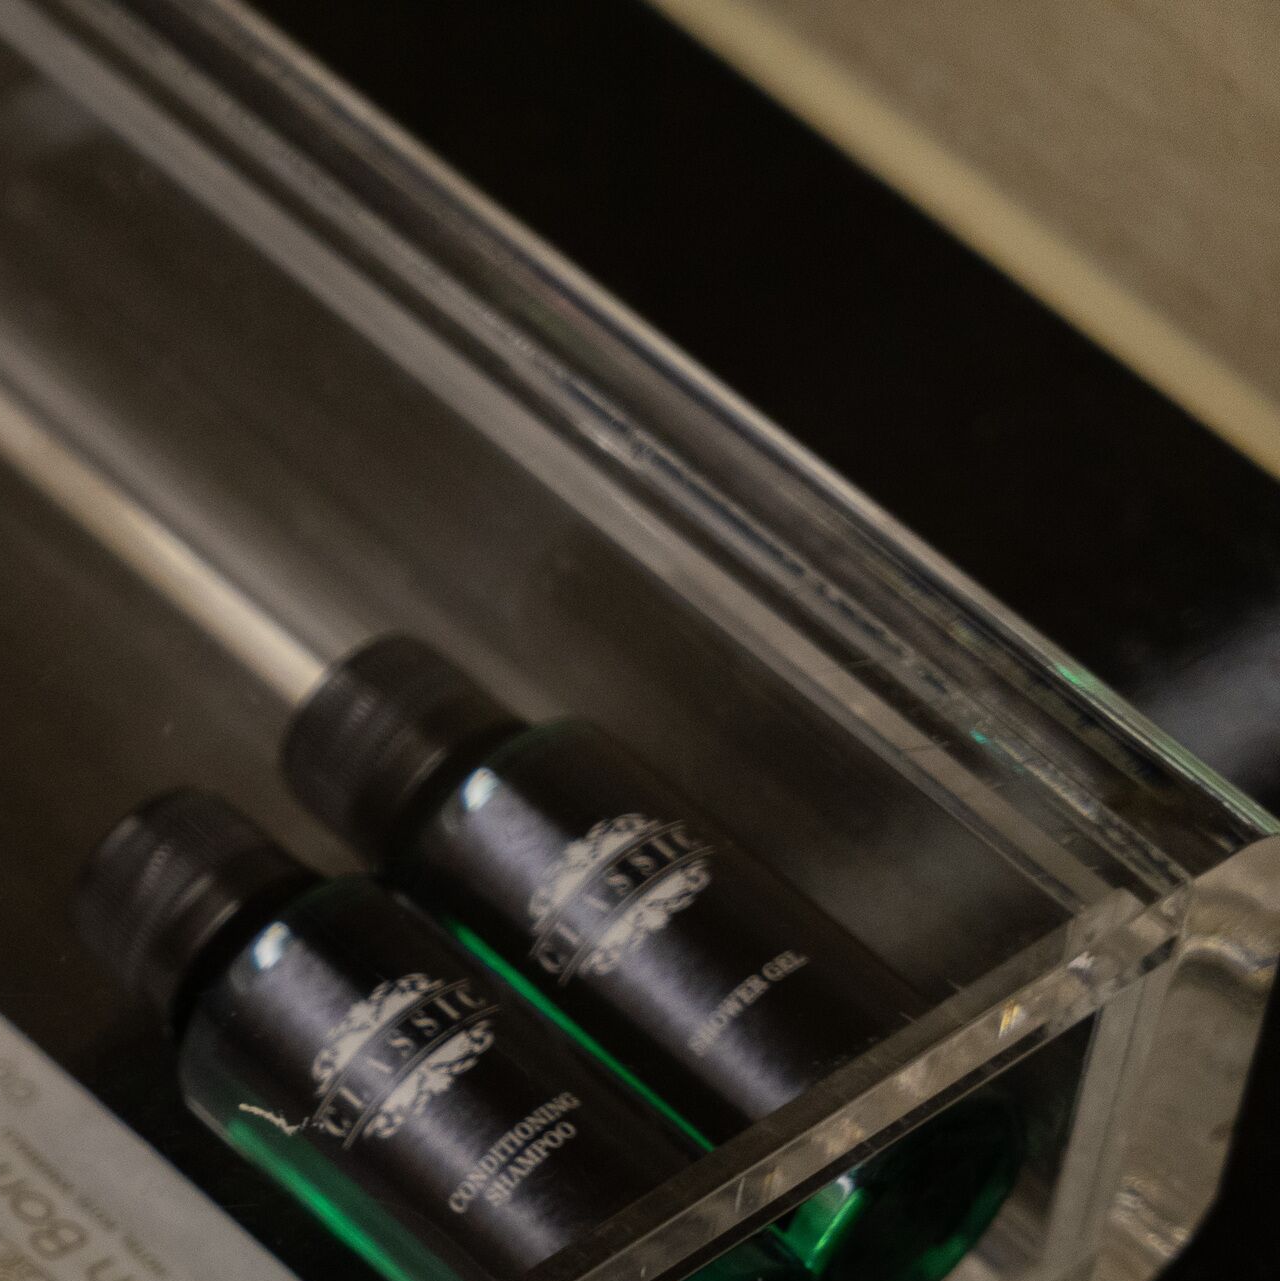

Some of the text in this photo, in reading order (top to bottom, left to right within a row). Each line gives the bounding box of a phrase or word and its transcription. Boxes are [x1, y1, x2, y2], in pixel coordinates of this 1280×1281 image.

[537, 826, 697, 976] CLASSIC
[320, 983, 486, 1140] CLASSIC
[685, 949, 810, 1058] SHOWER GEL
[448, 1091, 582, 1214] CONDITIONING
[483, 1120, 578, 1209] SHAMPOO
